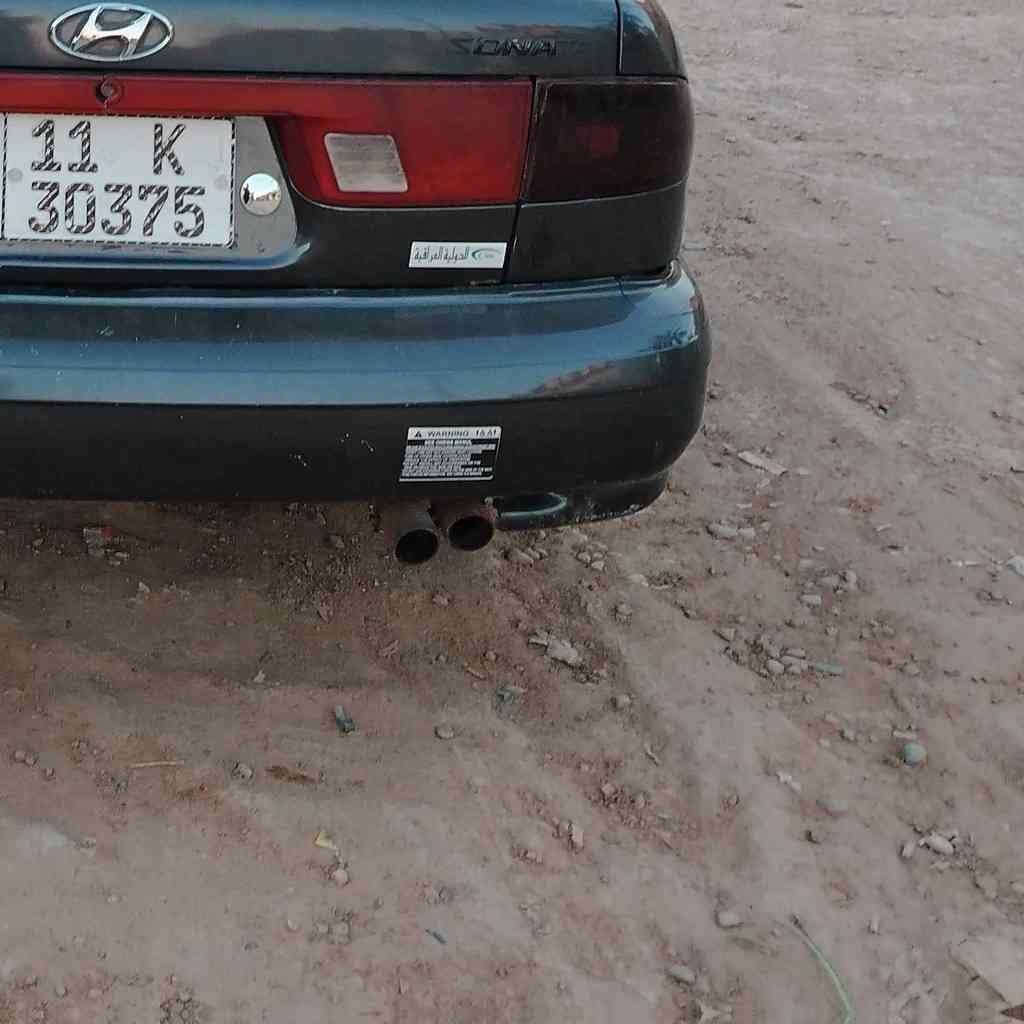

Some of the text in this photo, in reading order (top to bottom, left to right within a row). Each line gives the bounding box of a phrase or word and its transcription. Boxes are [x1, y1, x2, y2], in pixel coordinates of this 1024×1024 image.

[450, 36, 584, 57] SONA
[31, 119, 186, 175] 11 K
[28, 181, 206, 238] 30375
